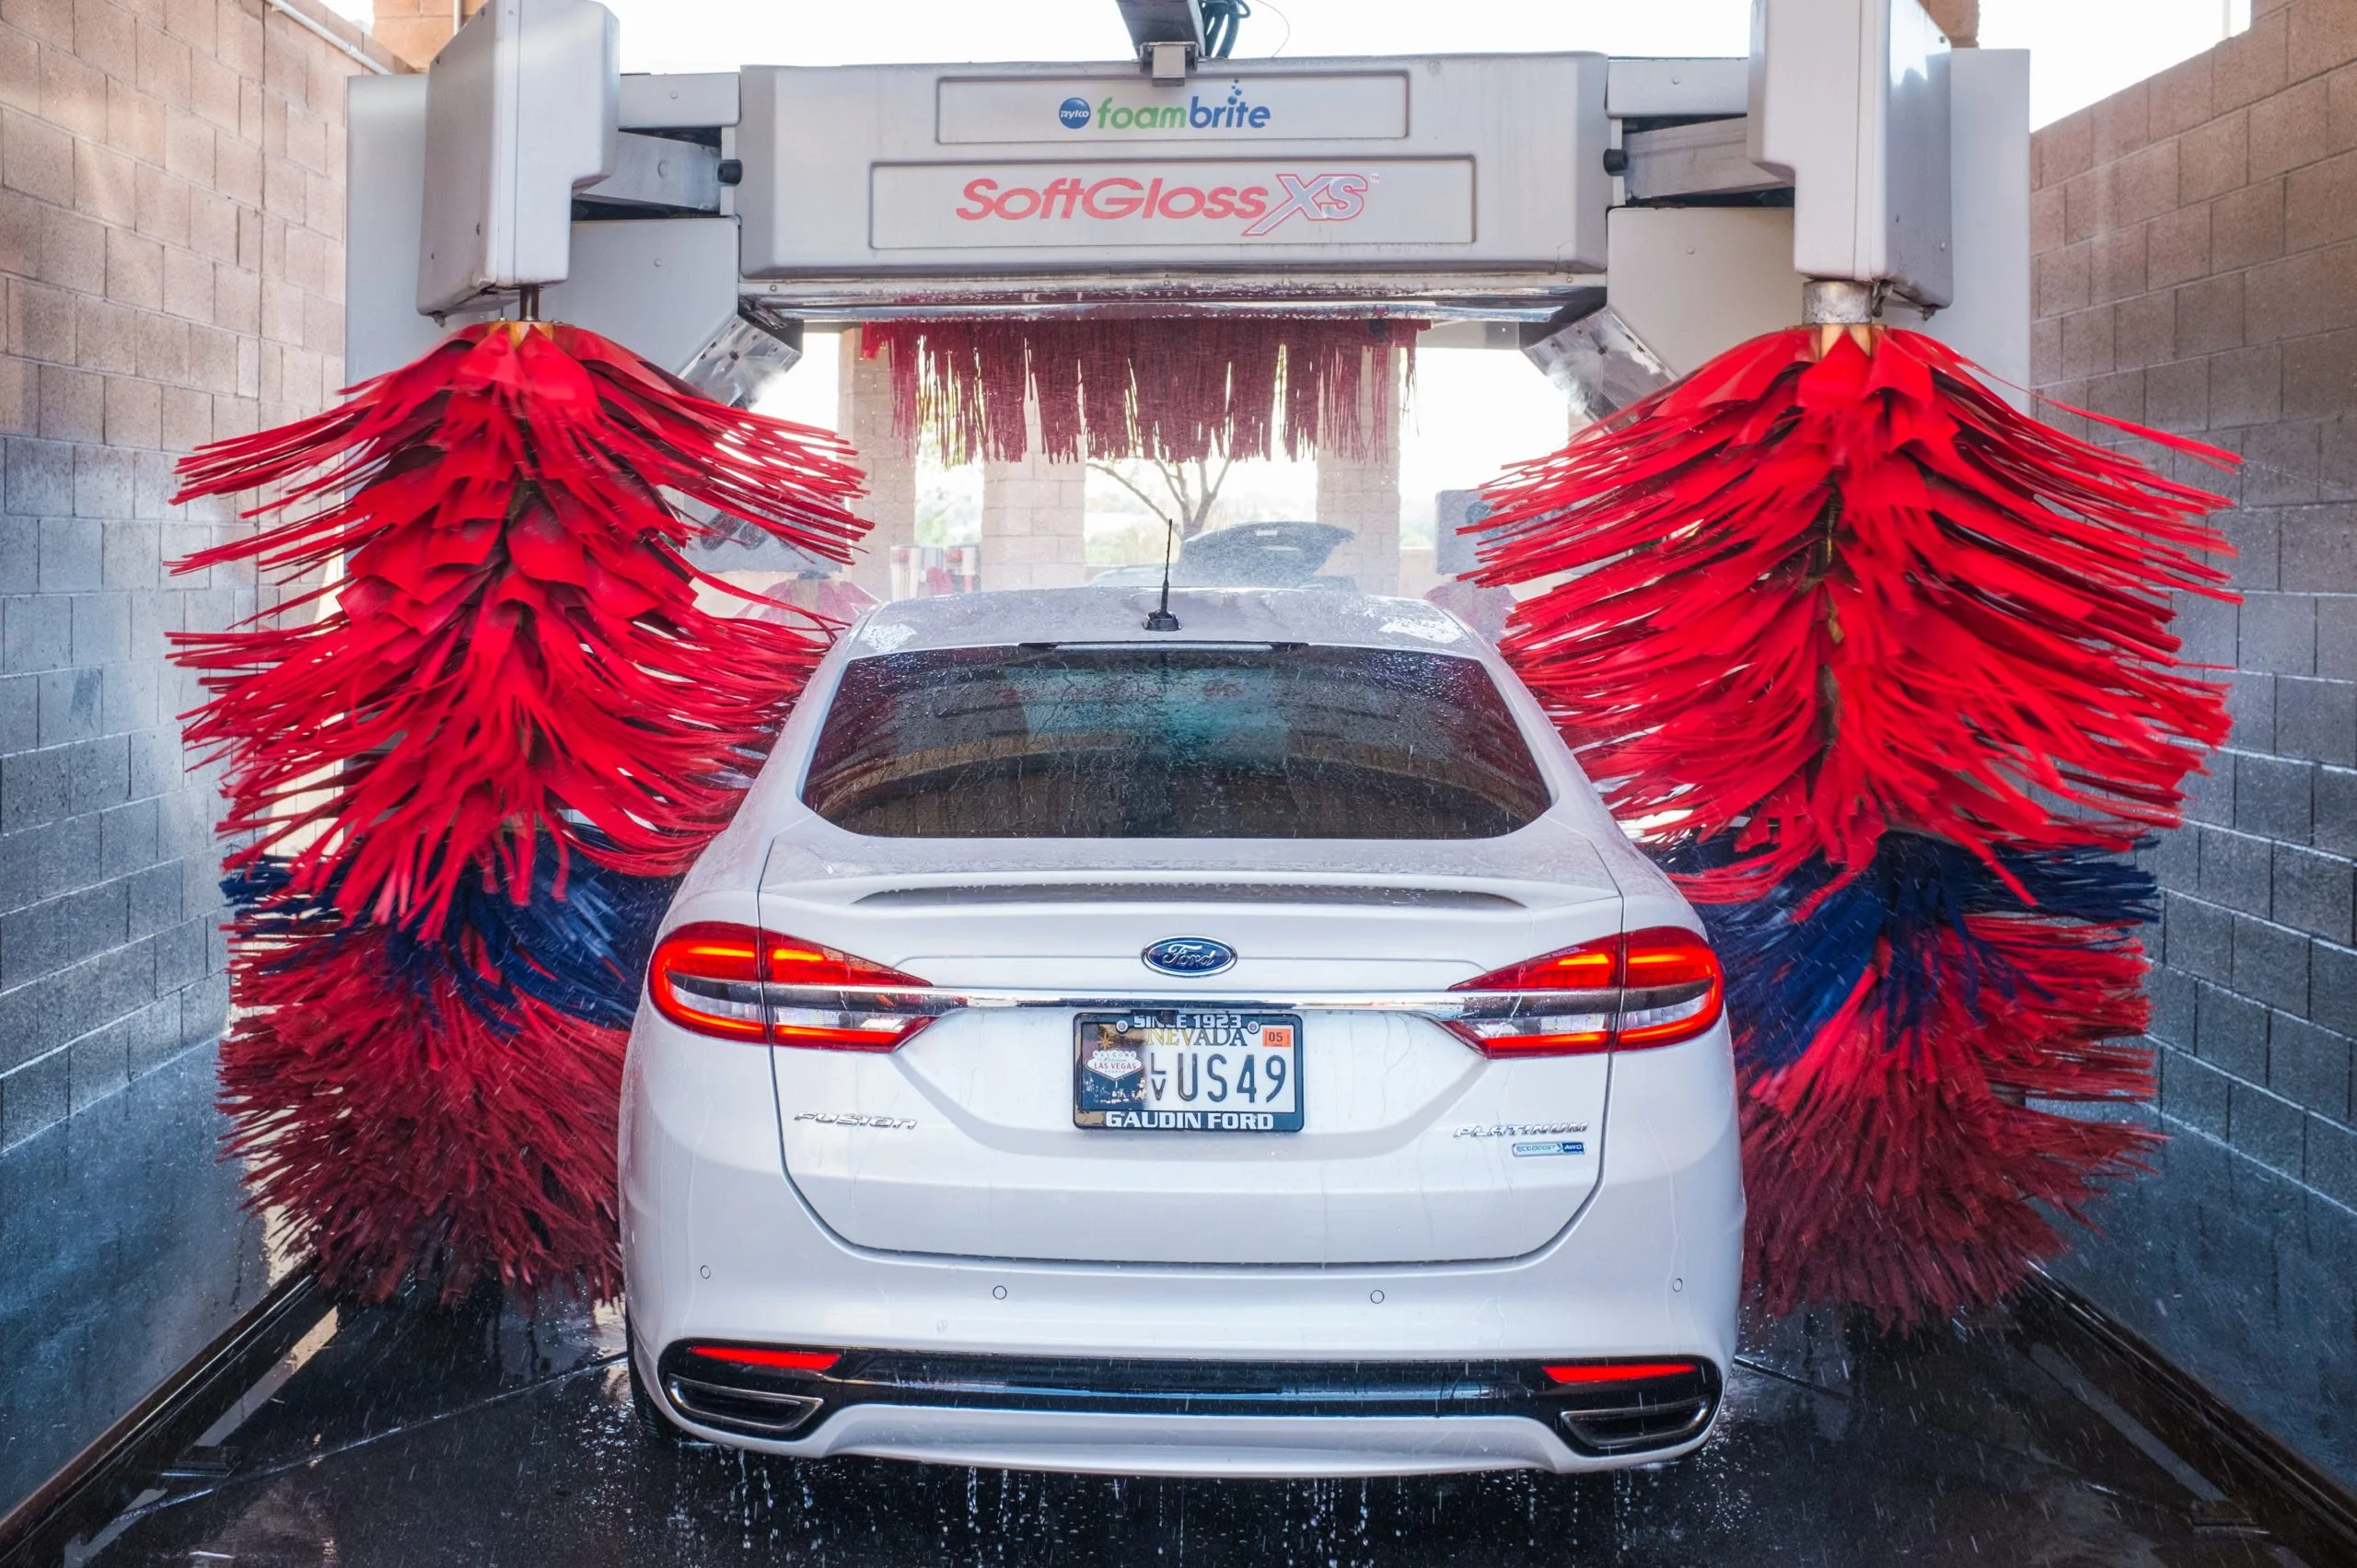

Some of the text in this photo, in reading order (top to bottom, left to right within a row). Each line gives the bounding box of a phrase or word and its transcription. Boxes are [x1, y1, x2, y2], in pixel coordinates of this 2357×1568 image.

[1097, 96, 1271, 129] foambrite
[1163, 944, 1216, 967] Ford
[1133, 1014, 1242, 1028] SINE 1923
[1145, 1028, 1248, 1047] NEVADA
[1268, 1031, 1283, 1042] 05
[1094, 1062, 1137, 1070] LAS VEGAS
[1106, 1110, 1274, 1130] GAUDIN FORD
[1453, 1121, 1587, 1138] PLATINUM
